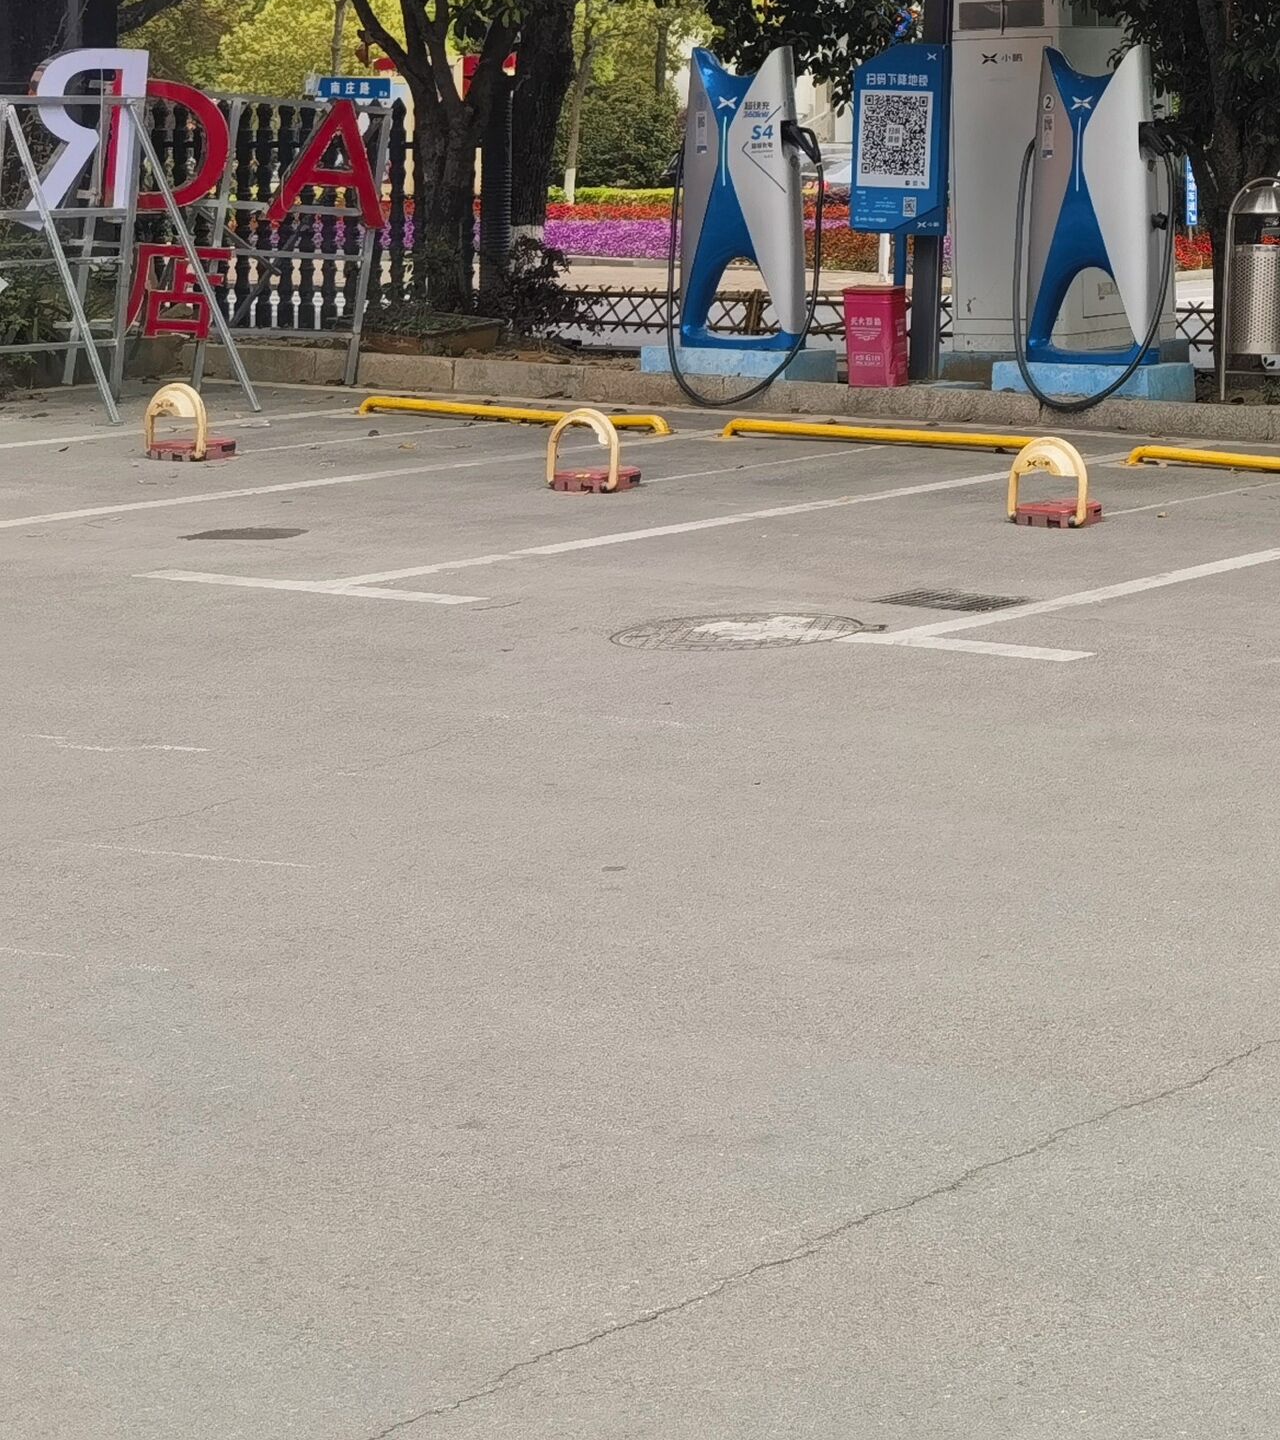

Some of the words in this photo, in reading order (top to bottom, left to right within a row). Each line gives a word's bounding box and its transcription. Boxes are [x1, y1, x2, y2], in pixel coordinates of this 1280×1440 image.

[866, 72, 928, 87] 扫码下降地锁
[330, 81, 370, 95] 南庄路
[1045, 96, 1052, 109] 2
[751, 125, 774, 140] S4
[126, 243, 234, 340] 店
